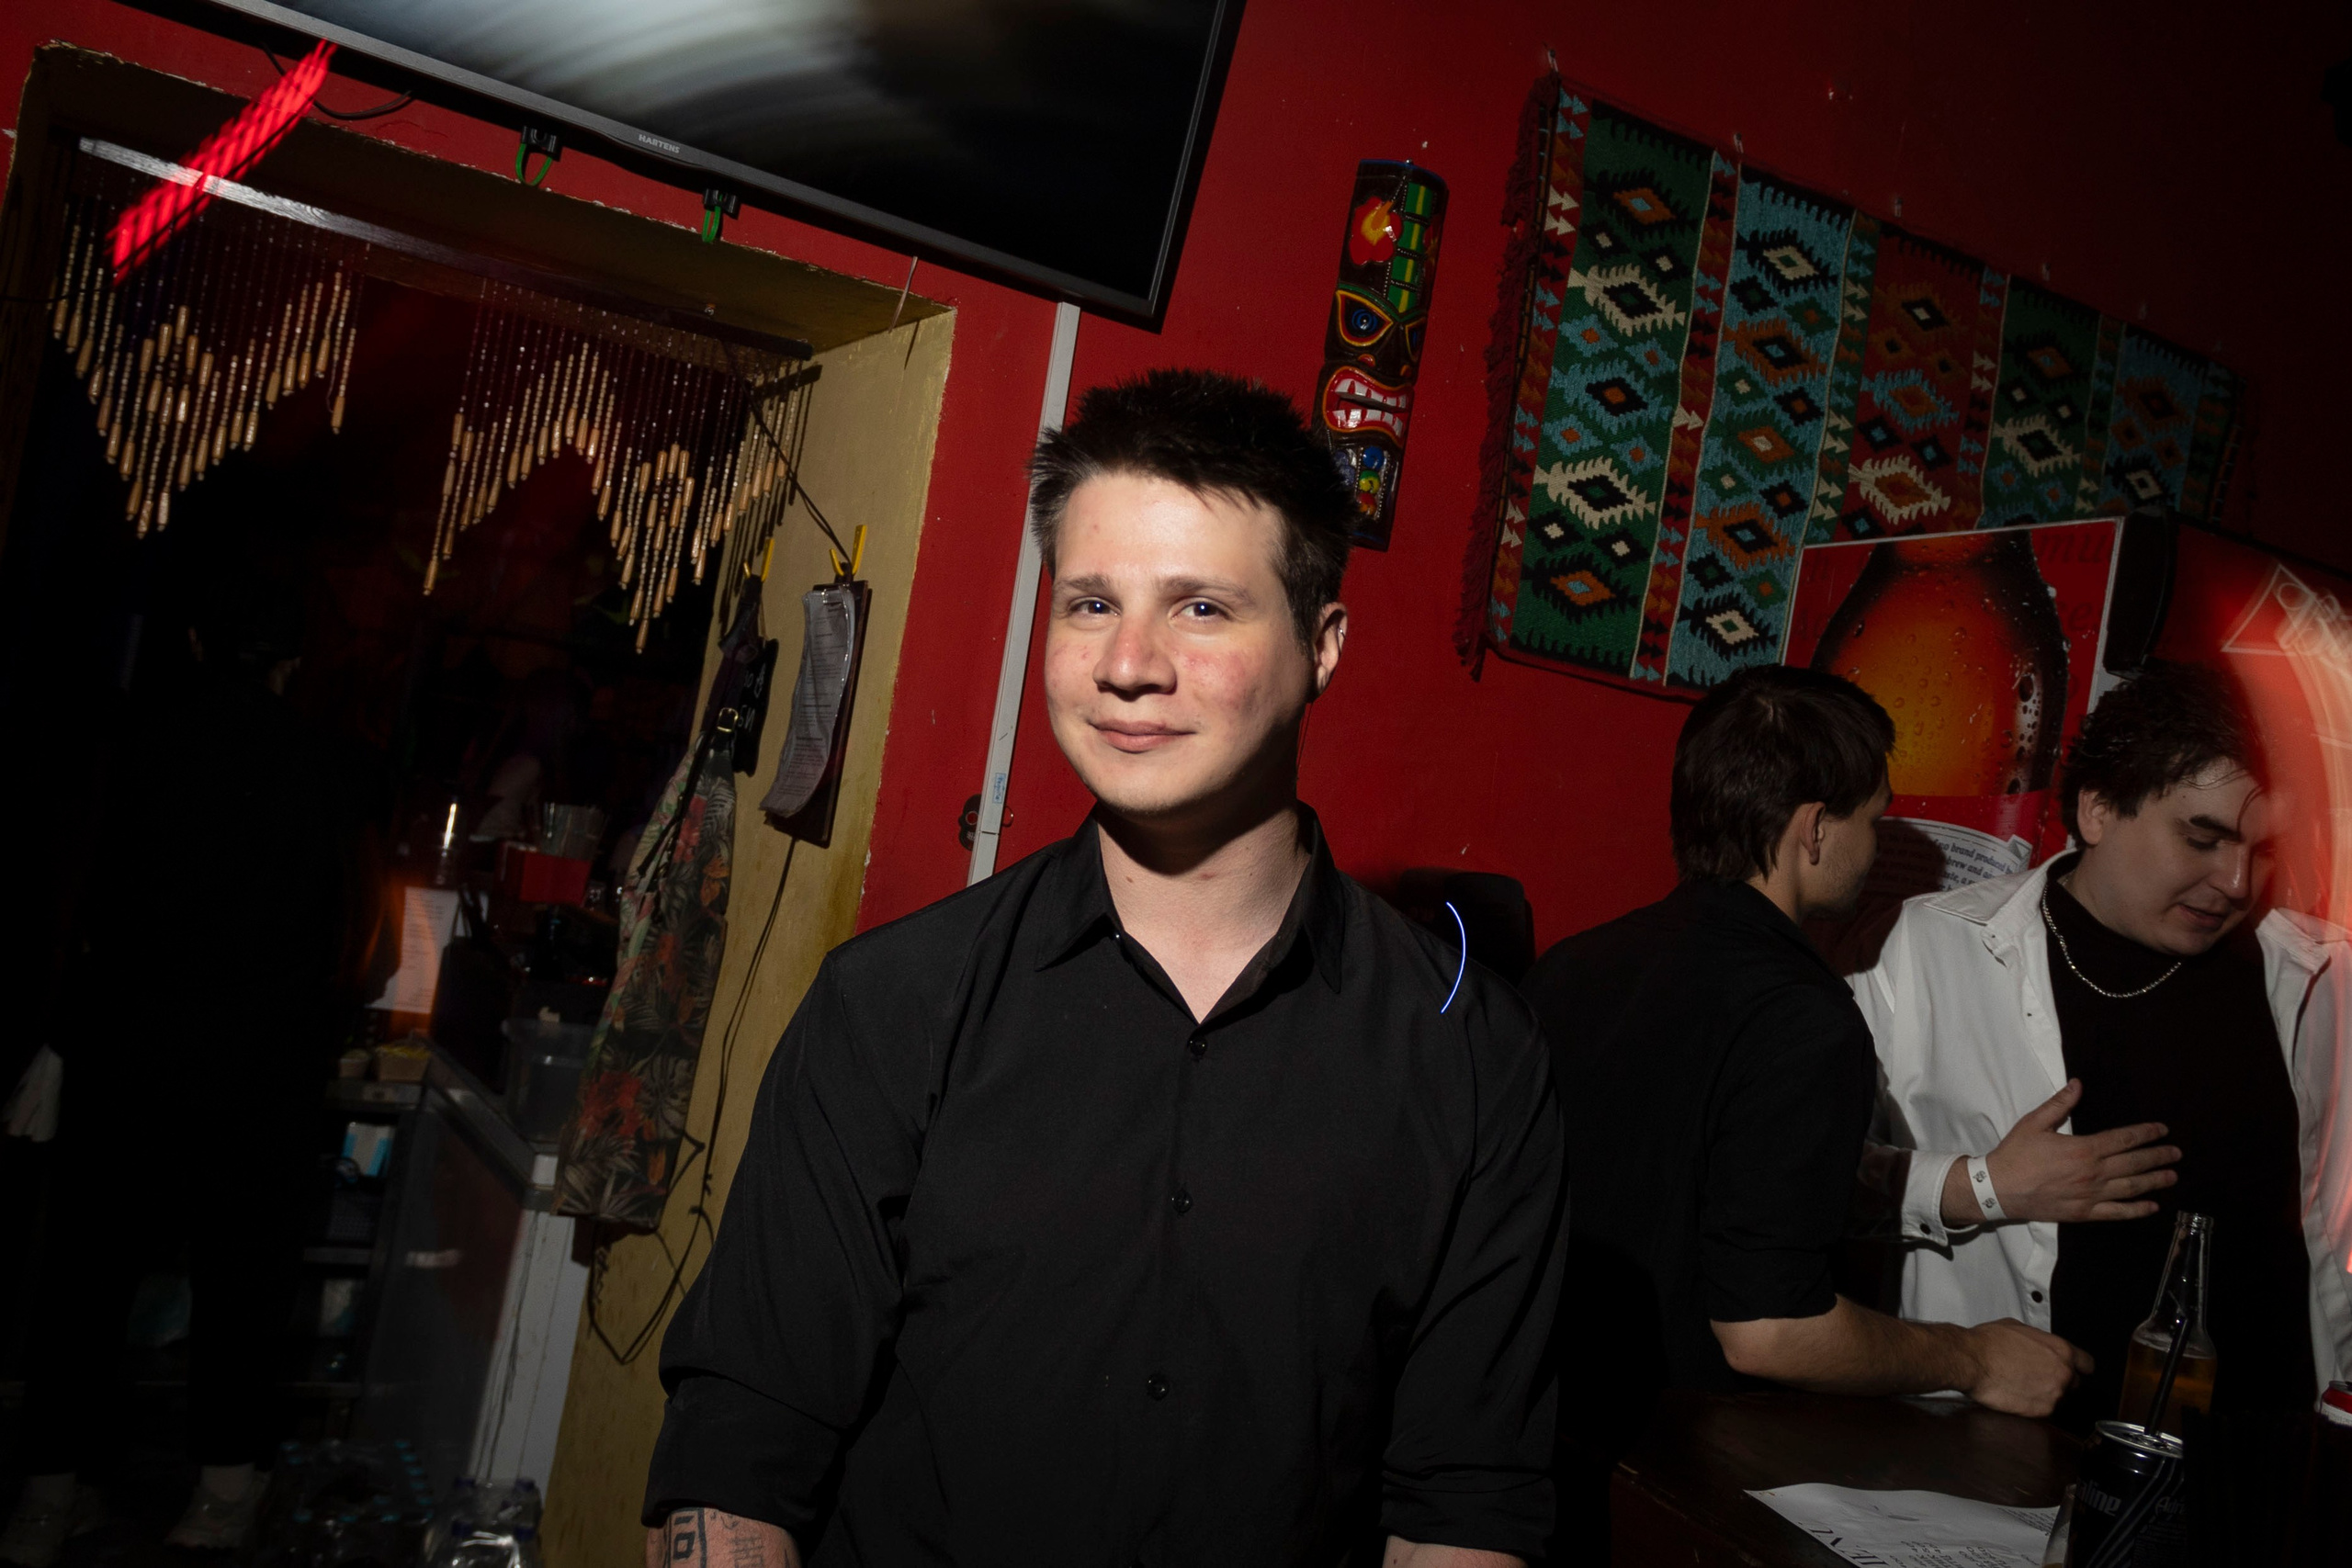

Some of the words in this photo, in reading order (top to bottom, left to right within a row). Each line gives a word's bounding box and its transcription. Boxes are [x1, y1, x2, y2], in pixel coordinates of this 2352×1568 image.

[638, 134, 681, 153] HARTENS
[1951, 841, 1976, 858] brand
[1946, 855, 1967, 870] brew
[1967, 864, 1984, 876] and
